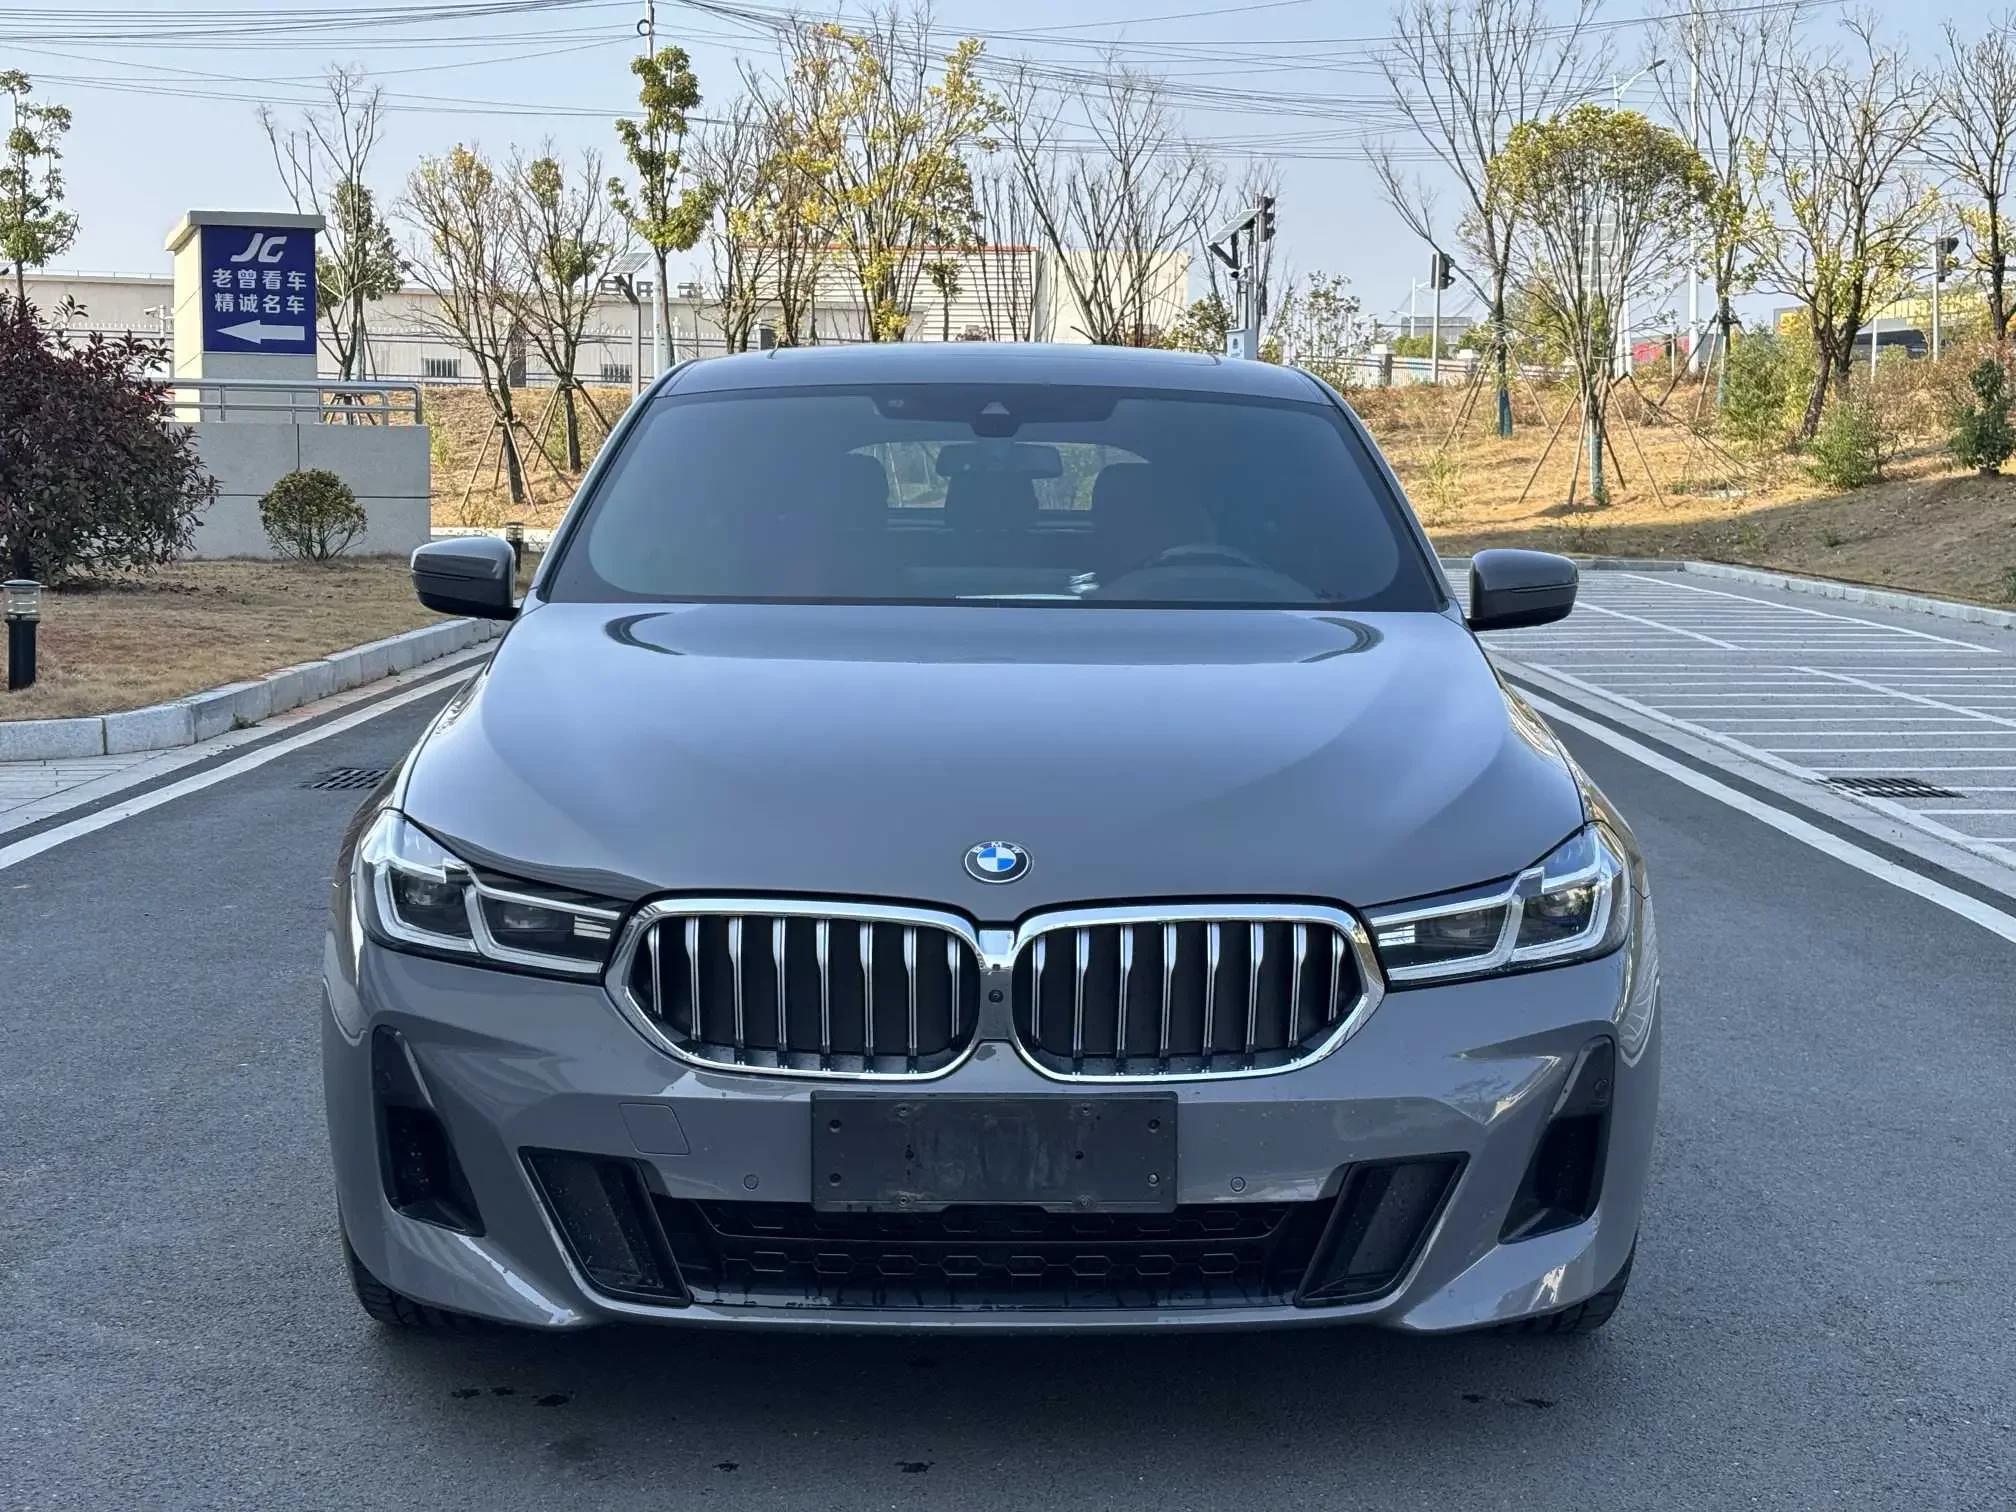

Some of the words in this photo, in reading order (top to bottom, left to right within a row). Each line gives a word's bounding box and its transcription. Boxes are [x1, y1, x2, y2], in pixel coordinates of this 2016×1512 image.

[212, 268, 307, 291] 老曾看车
[214, 292, 305, 315] 精诚名车
